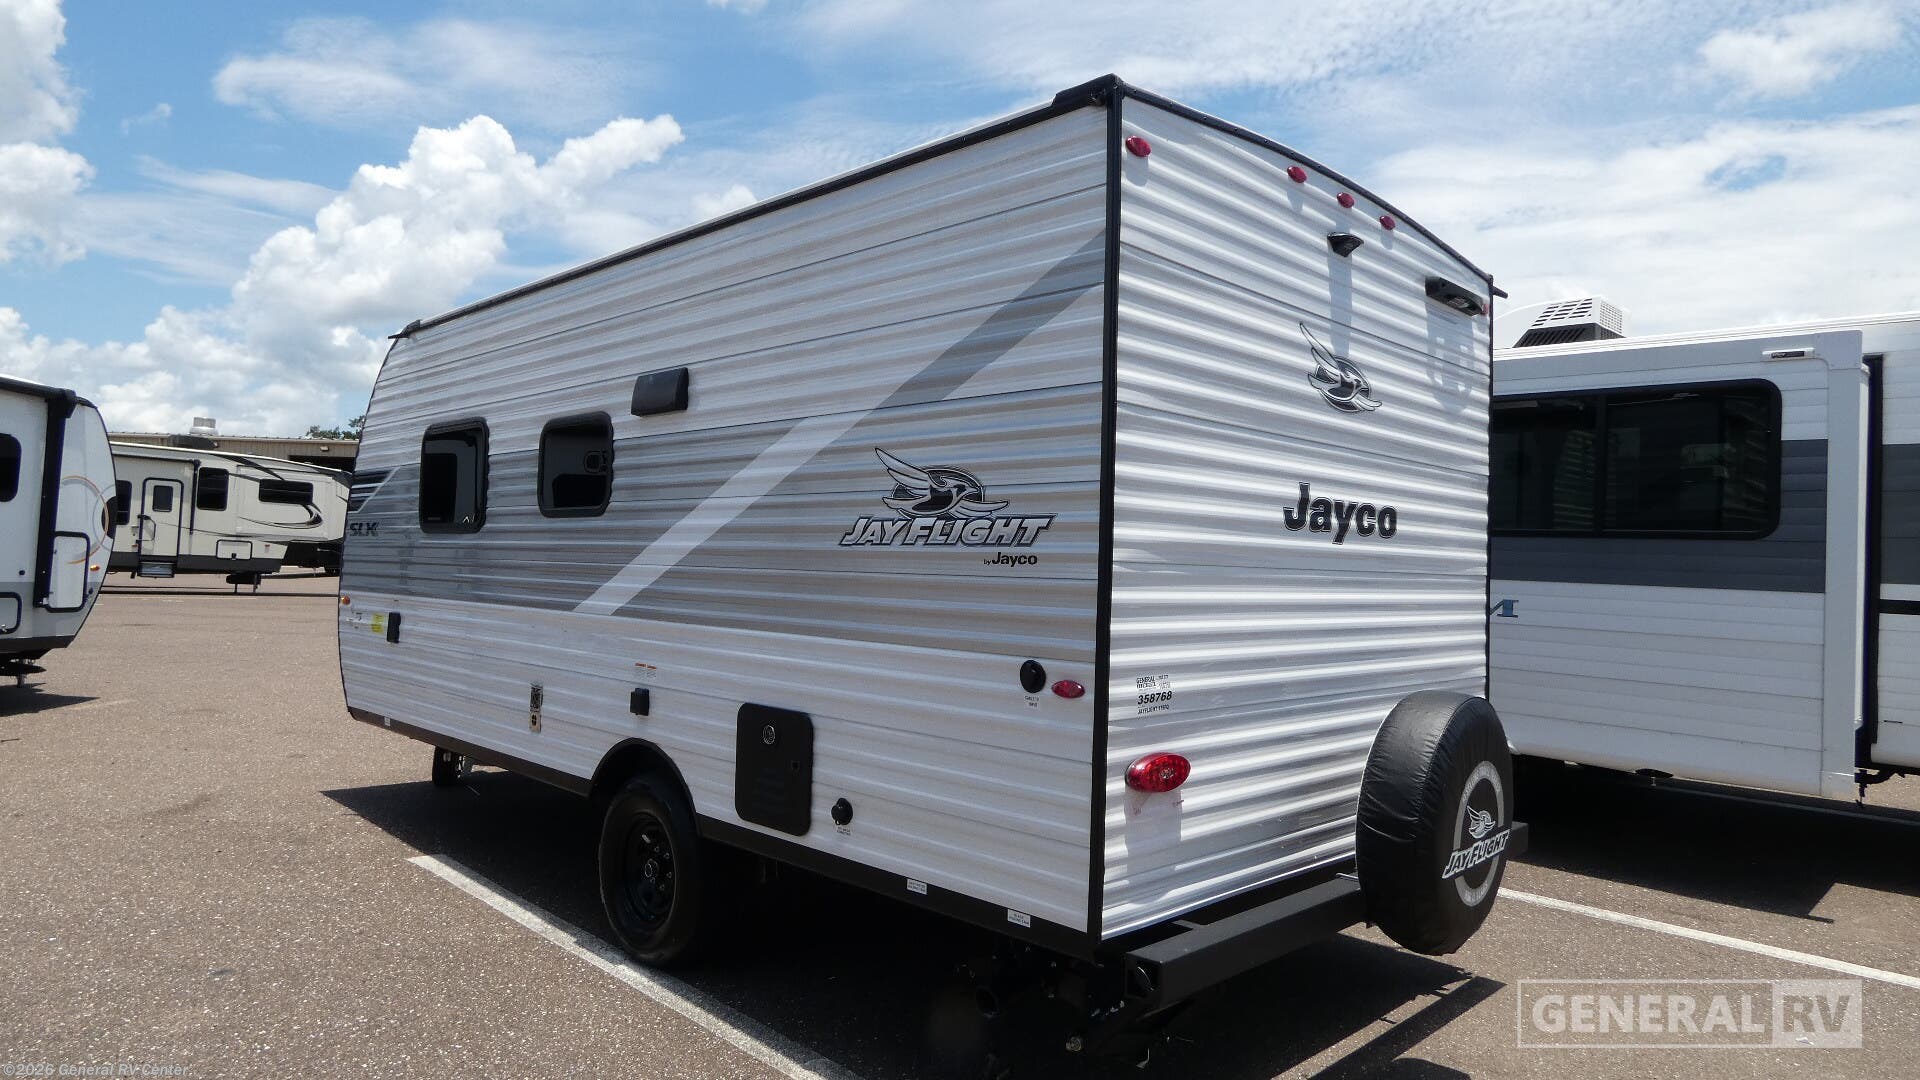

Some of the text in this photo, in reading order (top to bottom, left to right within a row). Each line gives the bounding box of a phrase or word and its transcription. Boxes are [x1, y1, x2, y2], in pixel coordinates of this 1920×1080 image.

[1283, 481, 1398, 545] Jayco
[350, 522, 379, 537] SLK
[991, 551, 1038, 568] Jayco
[1137, 690, 1173, 705] 358768
